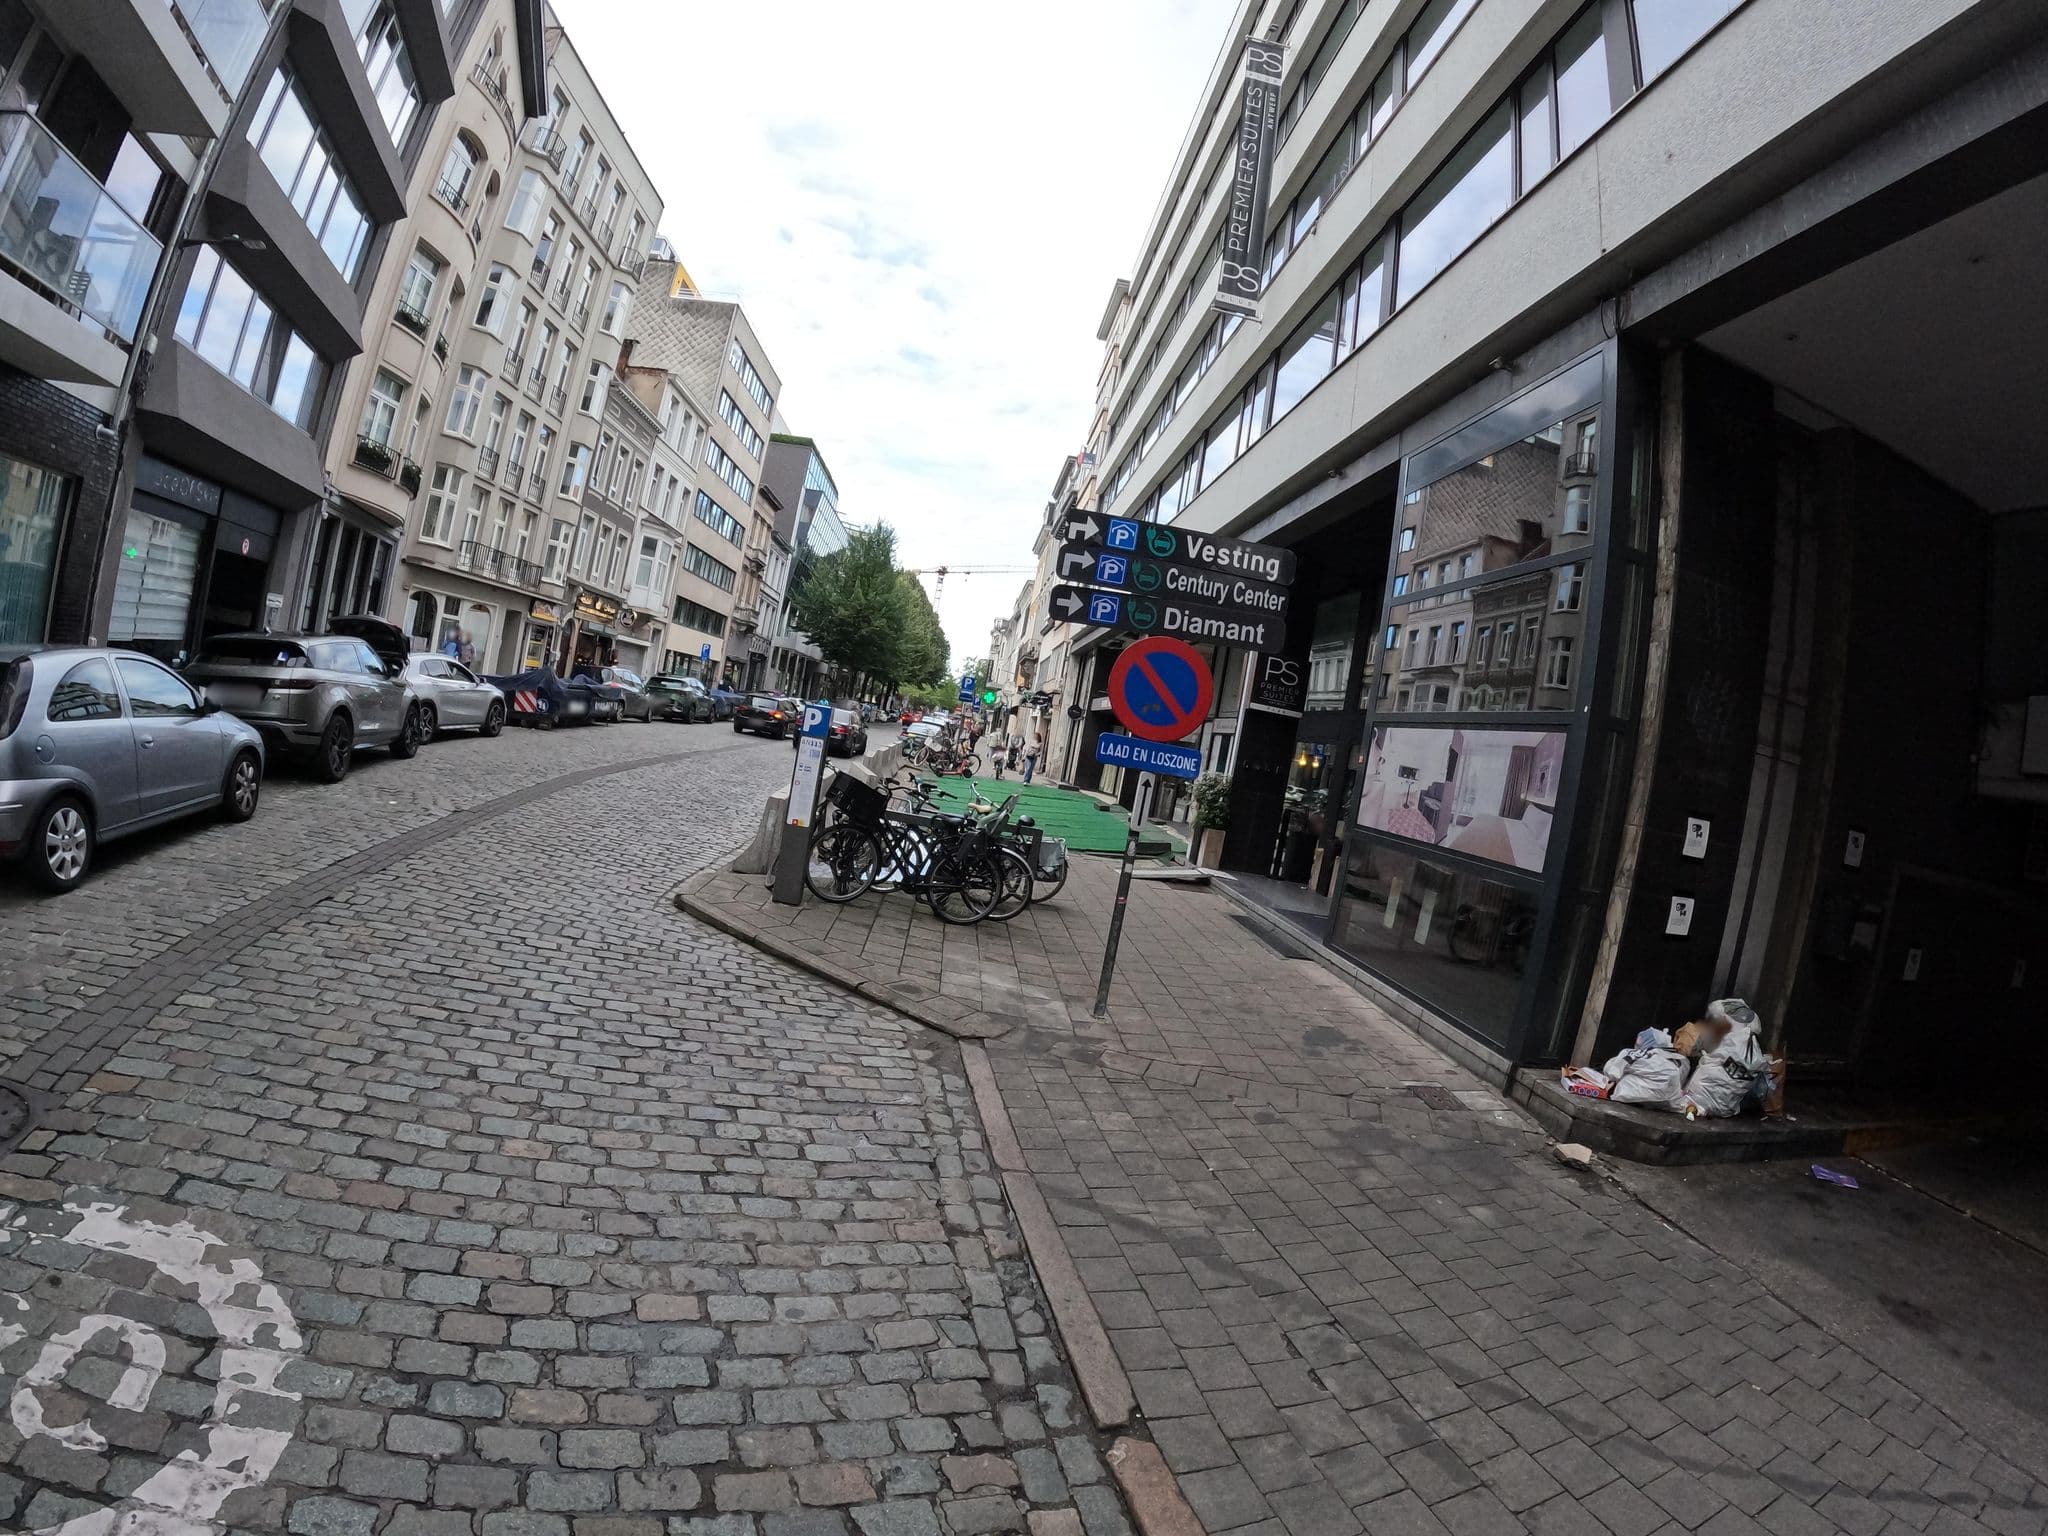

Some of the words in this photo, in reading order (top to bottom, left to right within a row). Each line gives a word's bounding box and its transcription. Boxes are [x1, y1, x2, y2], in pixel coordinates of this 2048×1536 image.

[1246, 47, 1283, 73] PS
[1242, 87, 1263, 155] SUITES
[1267, 92, 1277, 129] ANTWERP
[1229, 158, 1256, 252] PREMIER
[1219, 261, 1260, 293] PS
[1187, 535, 1281, 581] Vesting
[1166, 568, 1230, 605] Century
[1233, 581, 1287, 612] Center
[1164, 607, 1265, 645] Diamant
[1265, 656, 1299, 686] PS
[803, 707, 822, 732] P
[1100, 743, 1130, 761] LAAD
[1134, 747, 1148, 764] EN
[1151, 751, 1198, 773] LOSZONE
